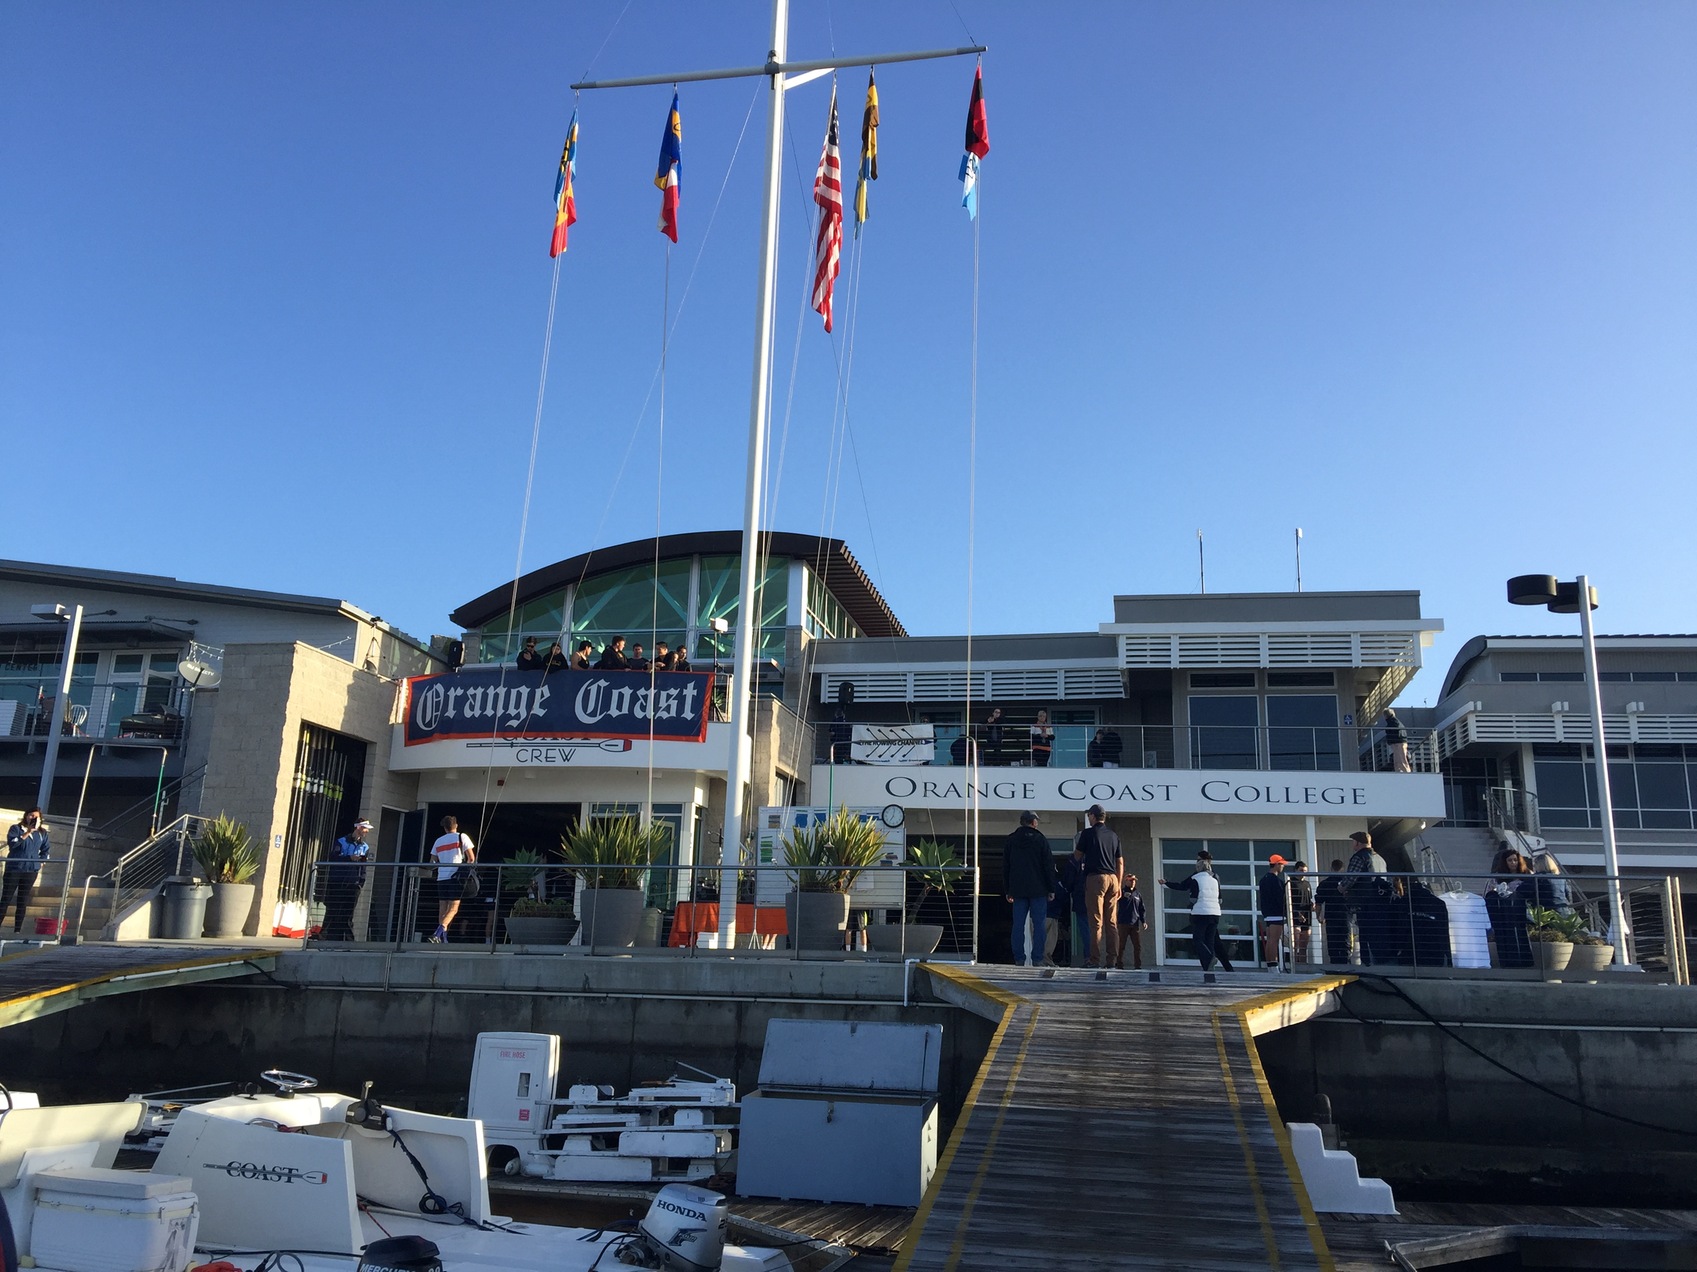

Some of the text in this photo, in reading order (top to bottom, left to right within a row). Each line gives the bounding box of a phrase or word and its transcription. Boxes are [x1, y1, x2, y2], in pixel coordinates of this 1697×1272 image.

[416, 678, 698, 731] Orange Coast
[516, 748, 577, 763] CREW
[885, 776, 1367, 804] ORANGE COAST COLLEGE
[512, 1051, 526, 1059] HOSE
[226, 1161, 299, 1184] COAST
[657, 1199, 708, 1222] HONDA
